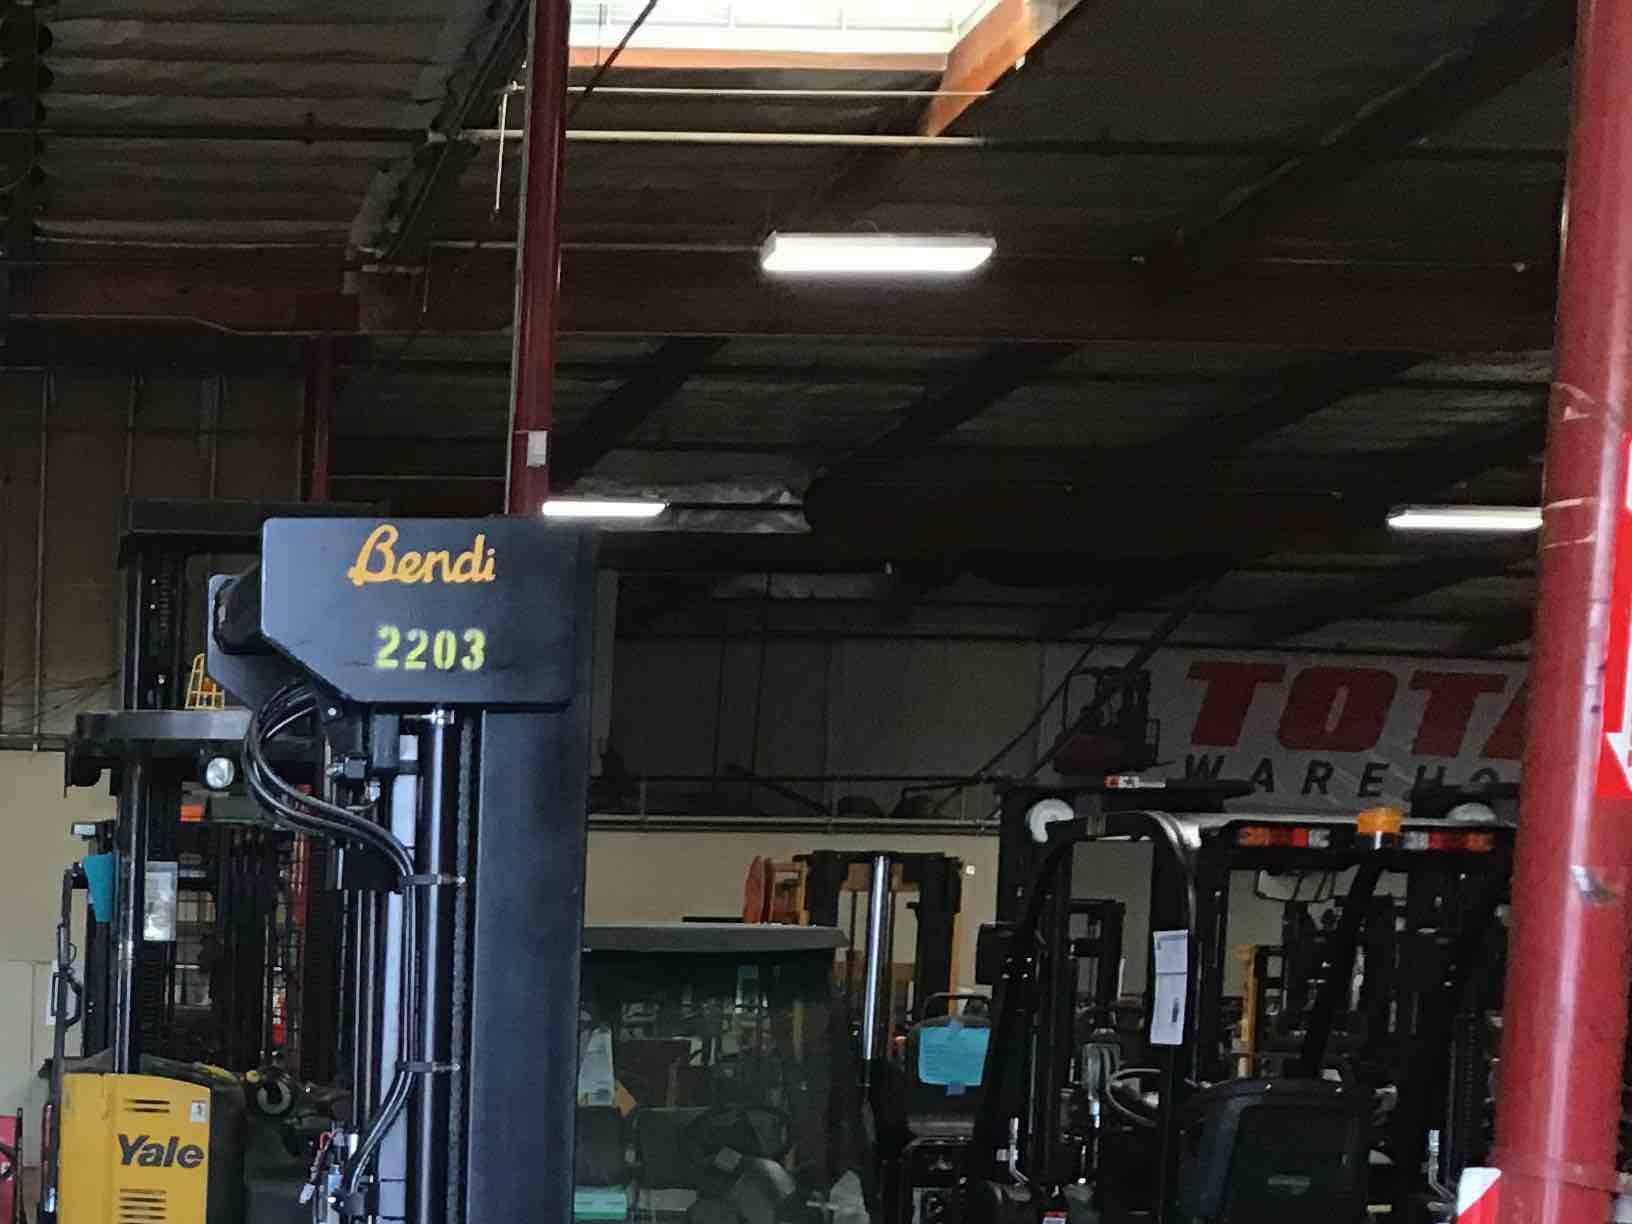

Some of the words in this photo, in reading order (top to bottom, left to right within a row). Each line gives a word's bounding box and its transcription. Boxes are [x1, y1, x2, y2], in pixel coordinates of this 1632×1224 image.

[347, 523, 496, 587] Bendi
[375, 624, 486, 671] 2203
[117, 1133, 205, 1169] Yale
